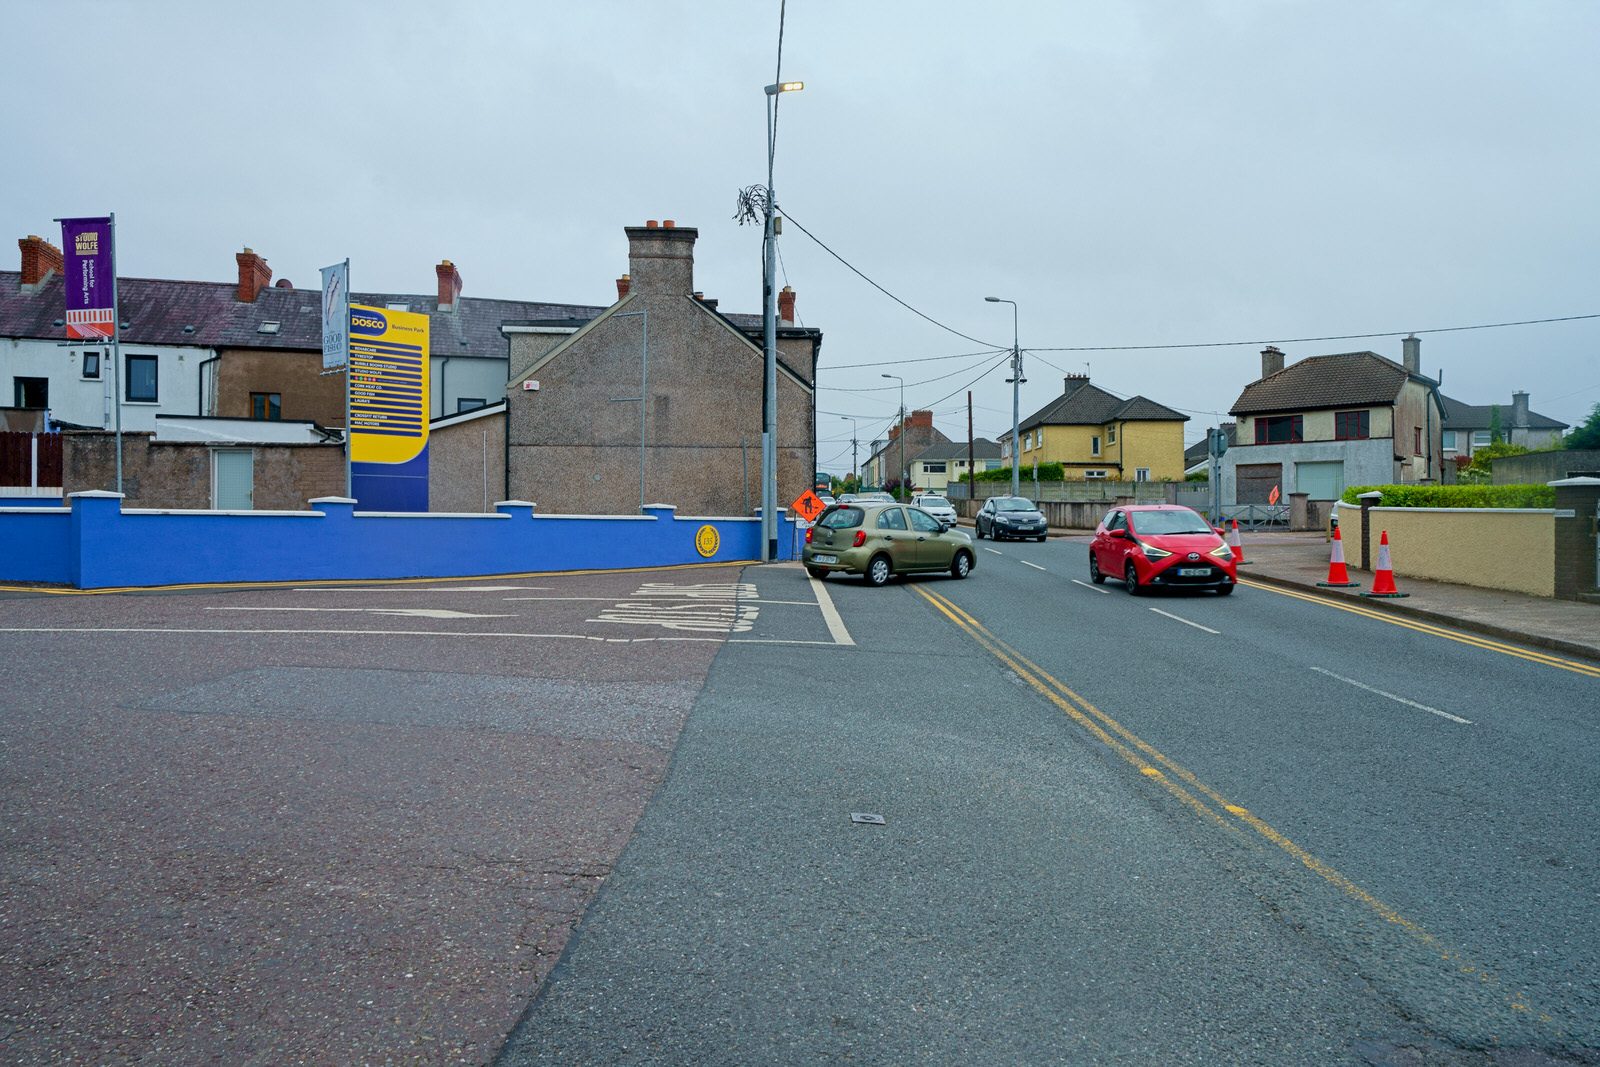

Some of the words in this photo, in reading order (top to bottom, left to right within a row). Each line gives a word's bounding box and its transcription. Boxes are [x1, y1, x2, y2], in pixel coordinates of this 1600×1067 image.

[75, 232, 98, 242] STUDIO
[75, 242, 98, 250] WOLFE
[352, 318, 384, 329] DOSCO
[392, 323, 413, 332] Business
[324, 333, 343, 344] GOOD
[630, 582, 759, 598] STOP
[585, 603, 759, 633] STOP
